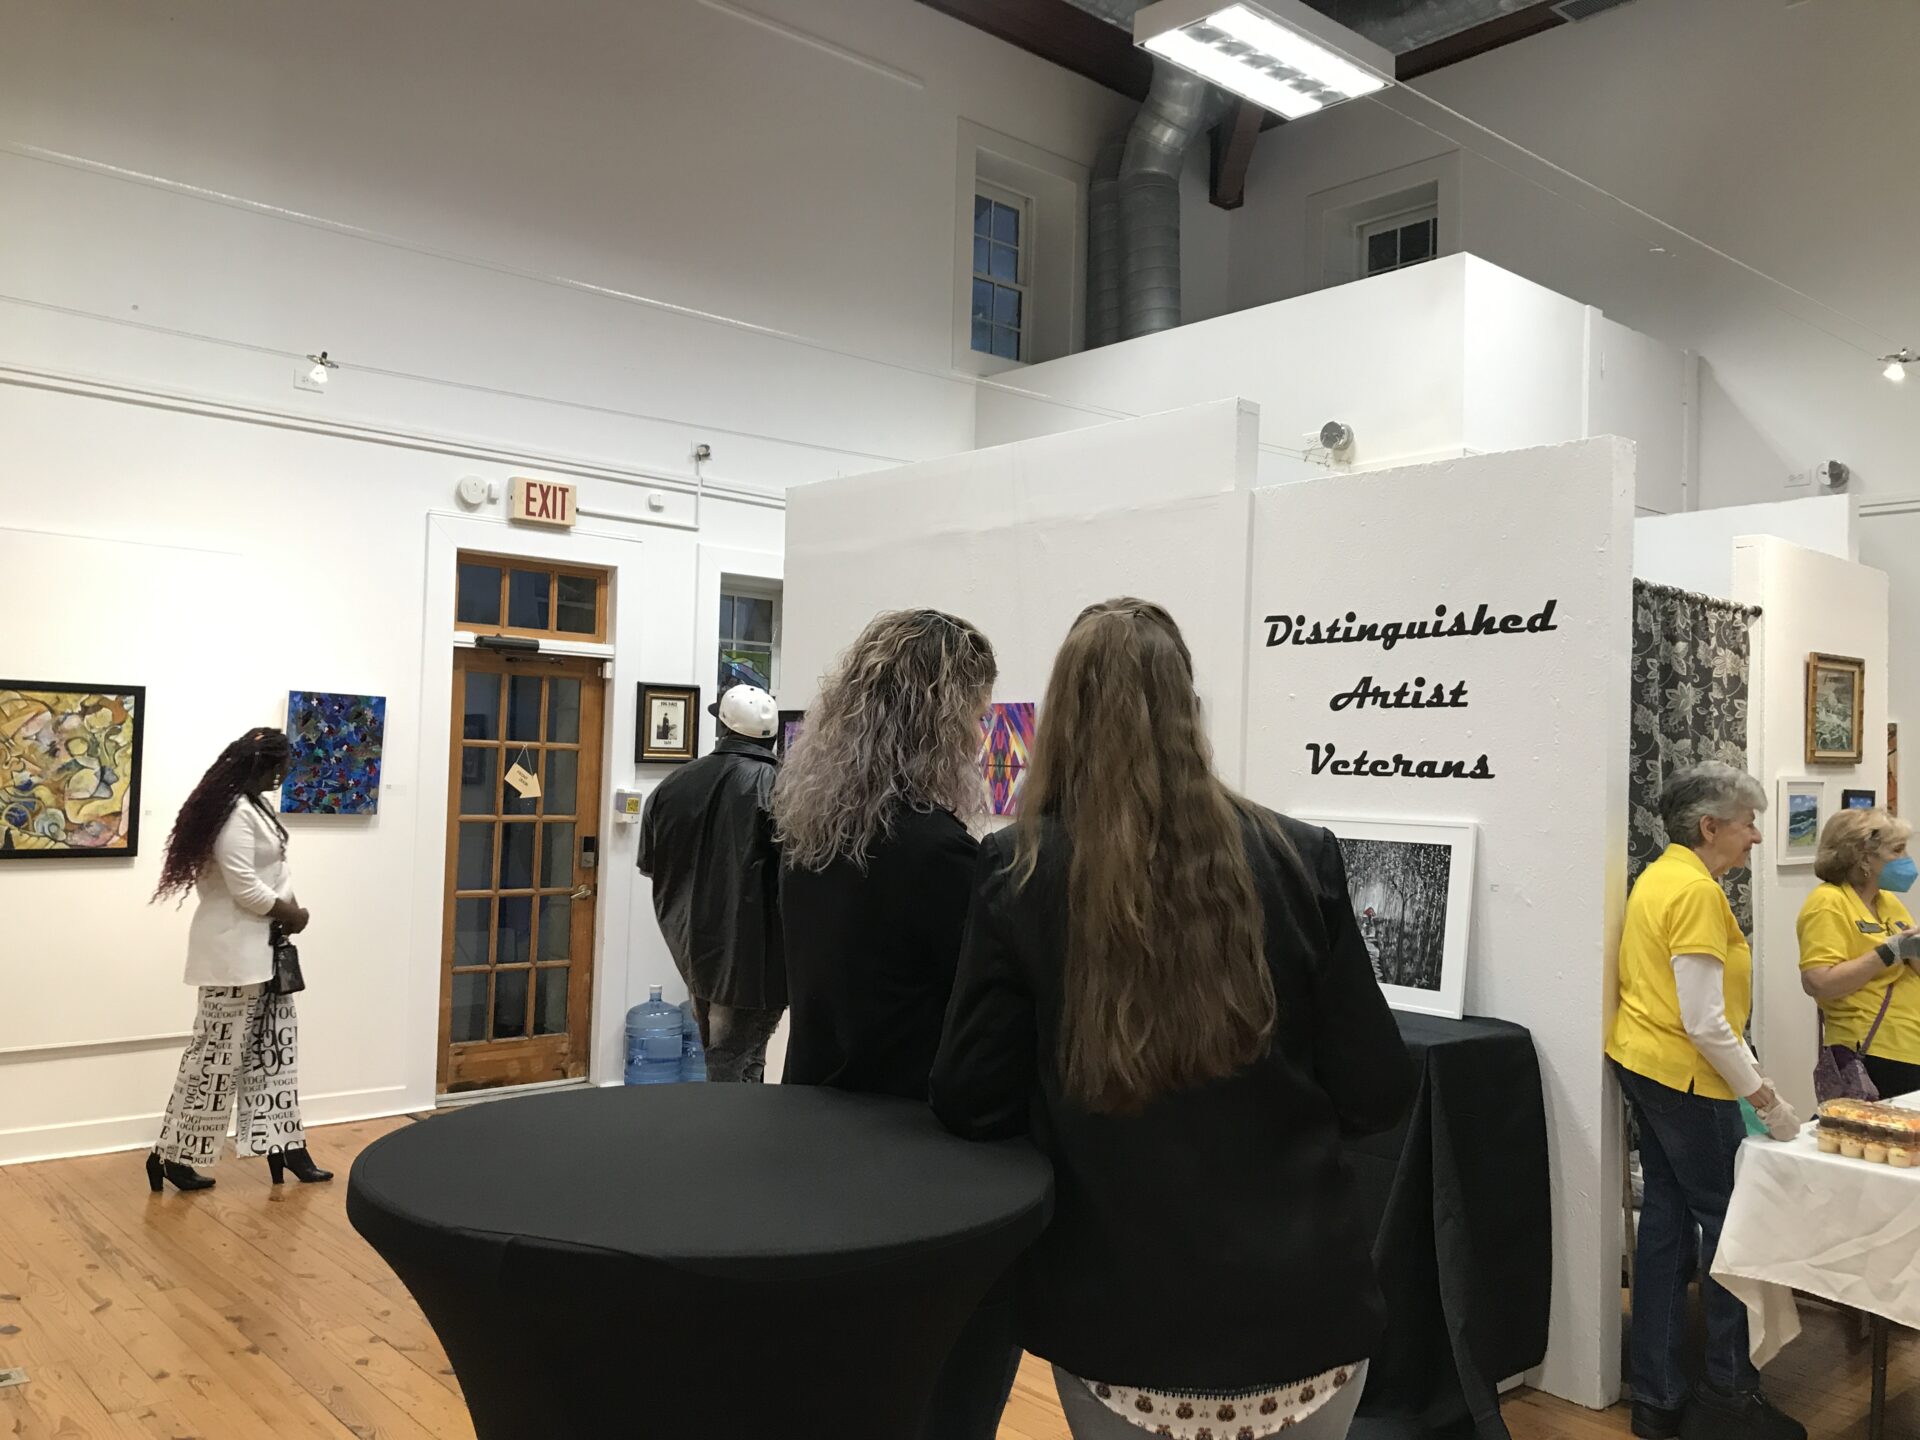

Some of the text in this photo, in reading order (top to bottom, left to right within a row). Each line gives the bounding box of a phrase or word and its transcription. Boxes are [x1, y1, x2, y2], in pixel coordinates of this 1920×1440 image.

[525, 481, 569, 521] EXIT
[1264, 600, 1557, 651] Distinguished
[1329, 676, 1469, 711] Artist
[1305, 743, 1496, 779] Veterans
